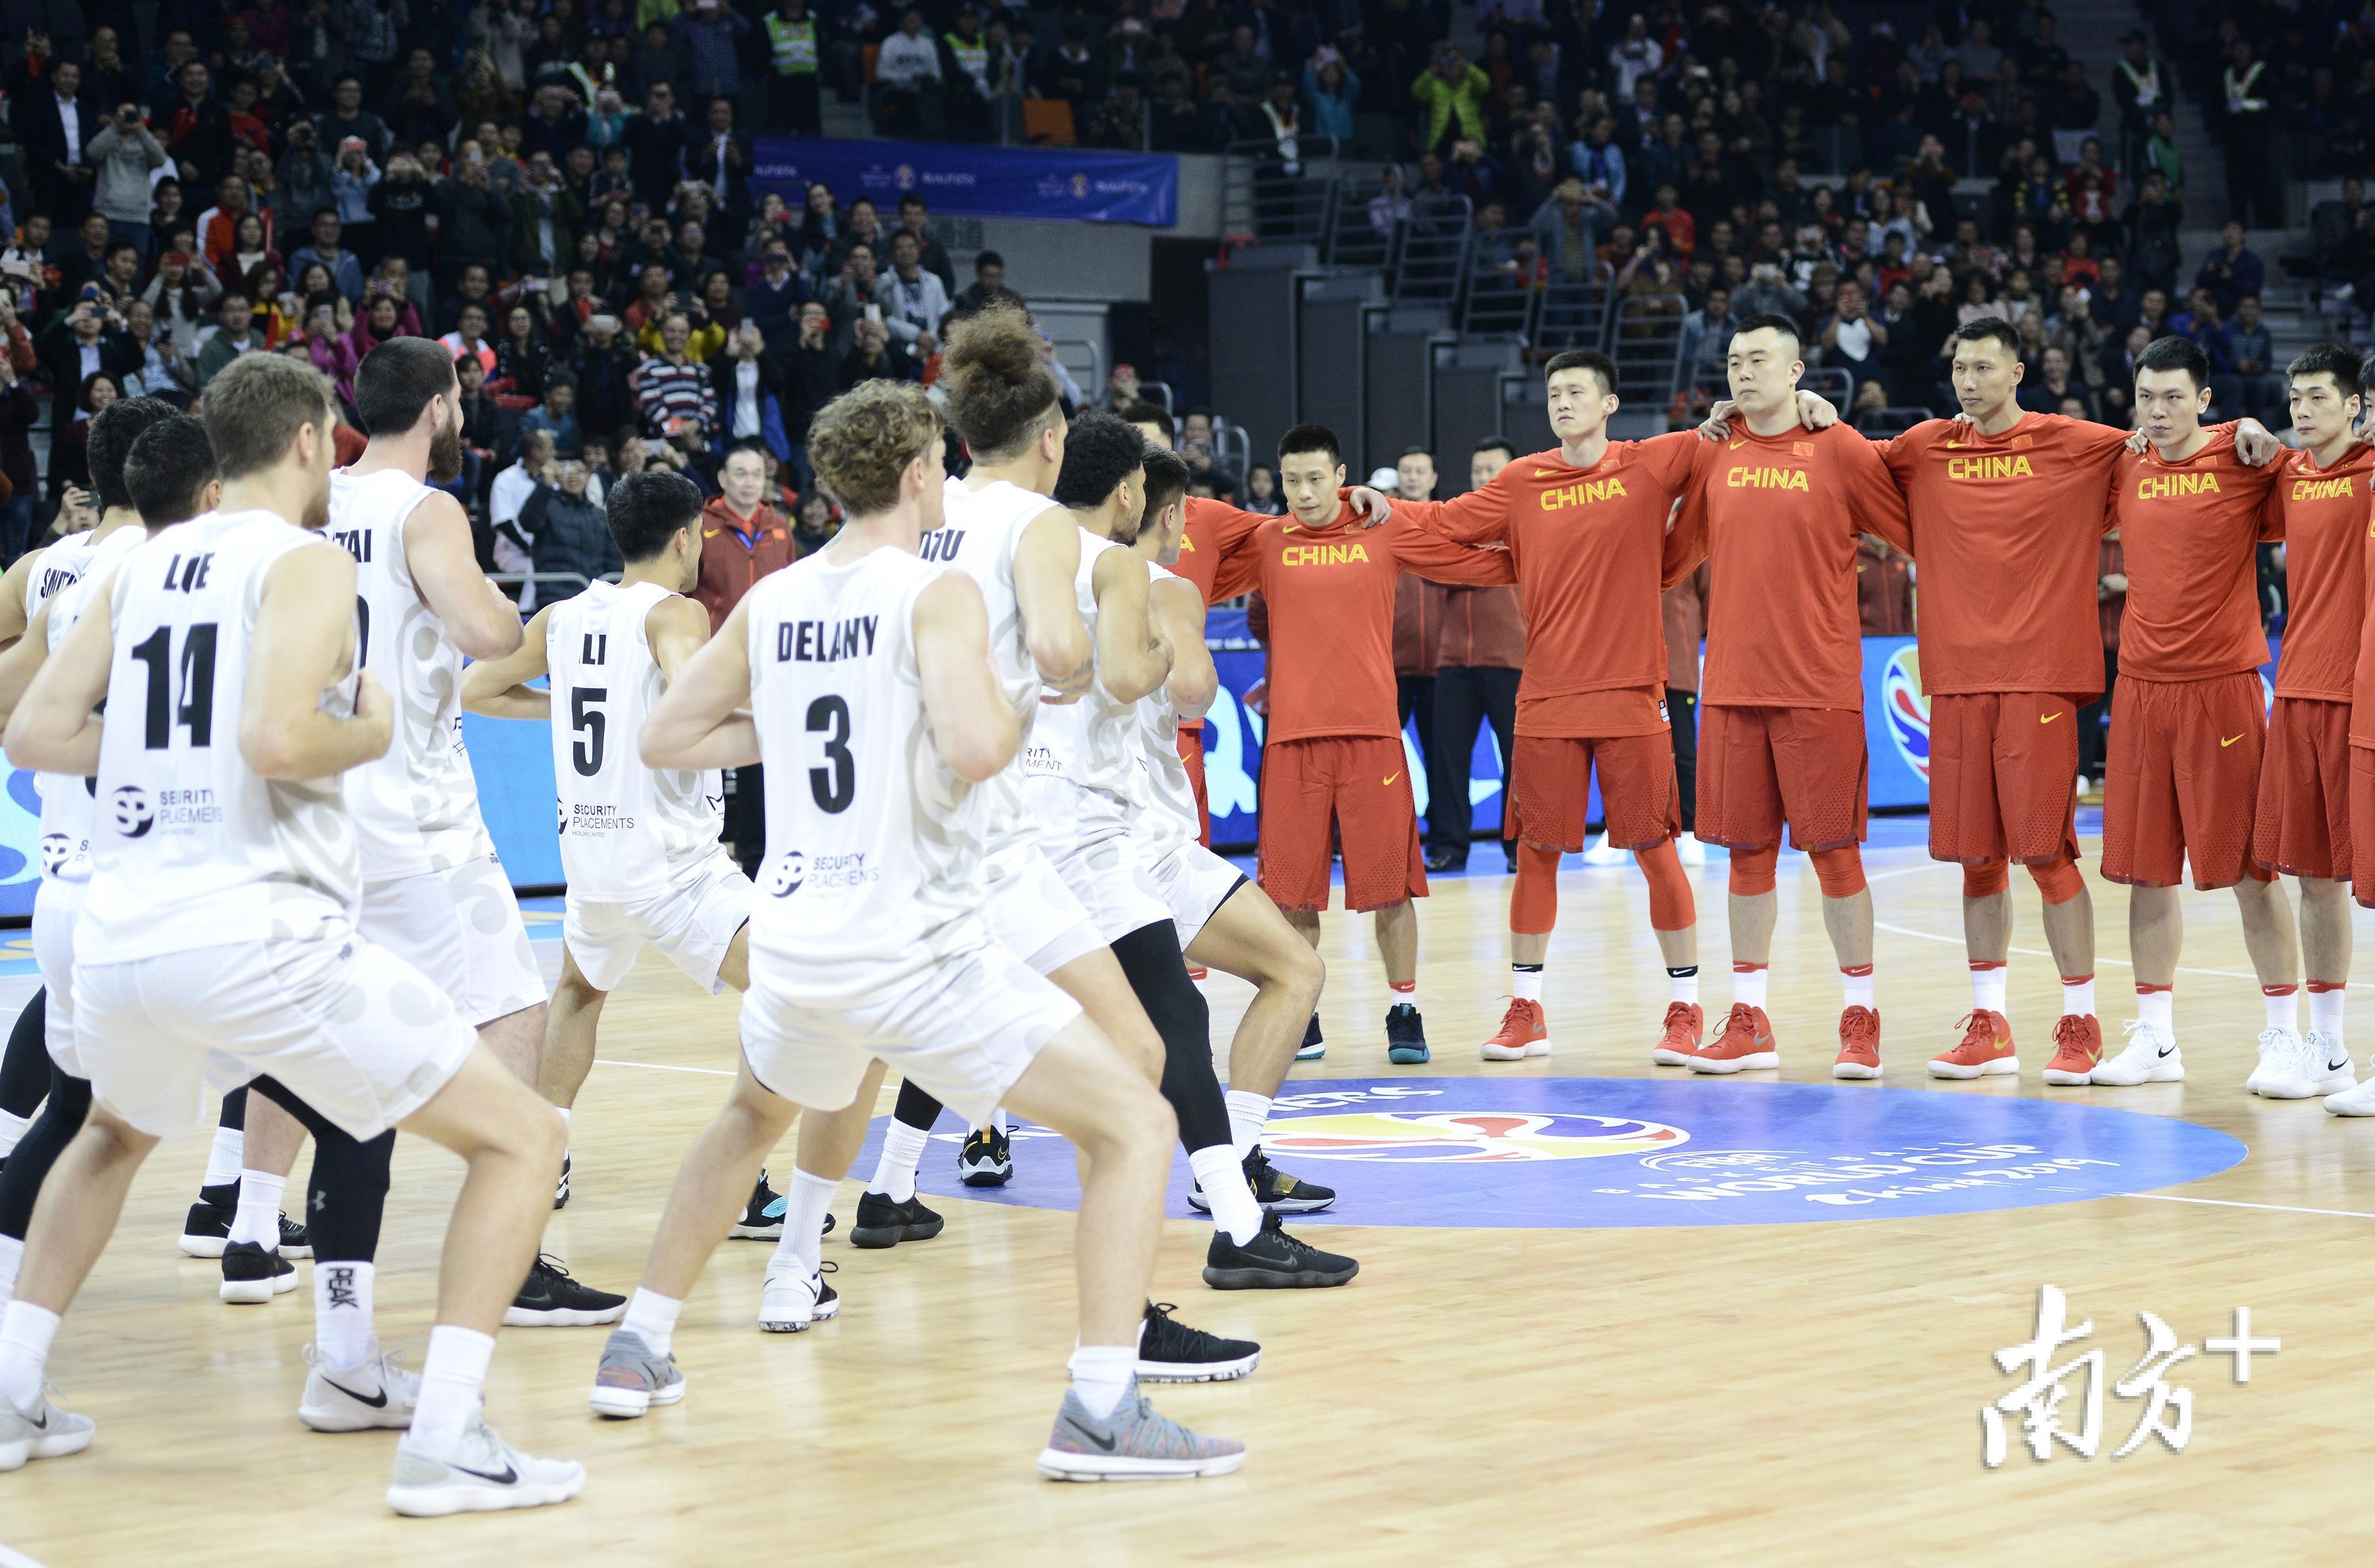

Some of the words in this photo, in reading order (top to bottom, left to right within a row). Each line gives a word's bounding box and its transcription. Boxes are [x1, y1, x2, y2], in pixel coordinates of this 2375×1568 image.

[1727, 466, 1810, 492] CHINA
[1948, 455, 2033, 479] CHINA
[1539, 478, 1627, 511] CHINA
[2138, 472, 2221, 500] CHINA
[2292, 477, 2353, 501] CHINA
[1281, 544, 1369, 567] CHINA
[778, 615, 879, 662] DELANY
[131, 622, 218, 749] 14
[571, 686, 607, 777] 5
[805, 694, 855, 814] 3
[573, 816, 634, 829] PLACEMENTS
[574, 804, 617, 816] SECURITY
[1591, 1142, 1975, 1195] BASKETBALL
[1635, 1163, 1917, 1201] WORLD
[1902, 1144, 2045, 1165] CUP
[1667, 1153, 1790, 1169] FIBA
[1960, 1158, 2121, 1179] 2019
[328, 1268, 360, 1309] PEAK
